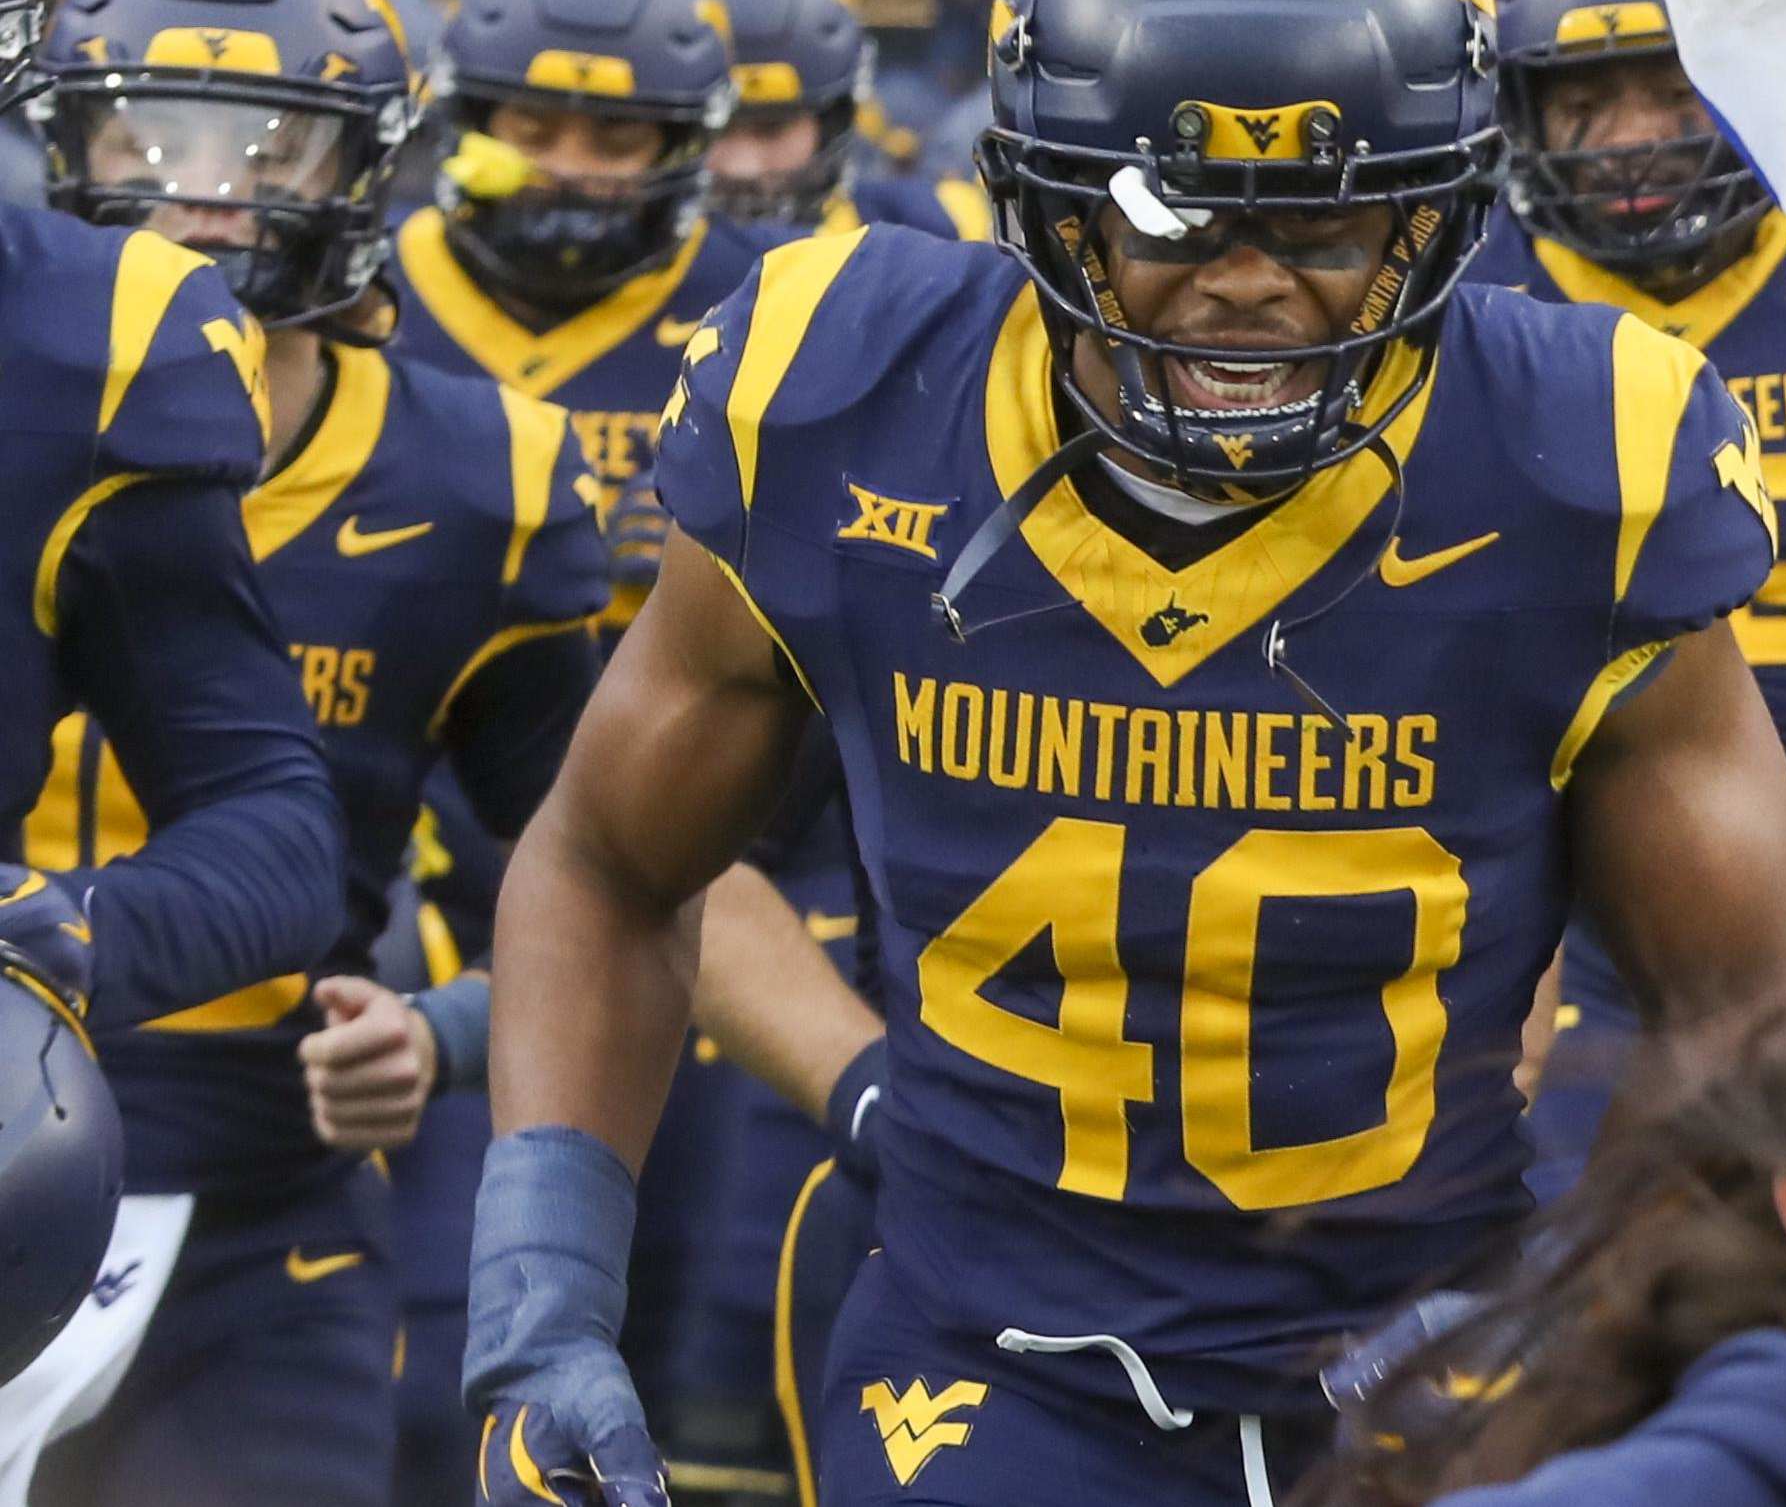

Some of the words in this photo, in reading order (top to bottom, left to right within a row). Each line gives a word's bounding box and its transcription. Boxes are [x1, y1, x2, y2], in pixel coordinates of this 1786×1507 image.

[1392, 204, 1442, 263] RADS
[837, 483, 949, 560] XII
[892, 671, 1438, 812] MOUNTAINEERS
[917, 816, 1471, 1211] 40
